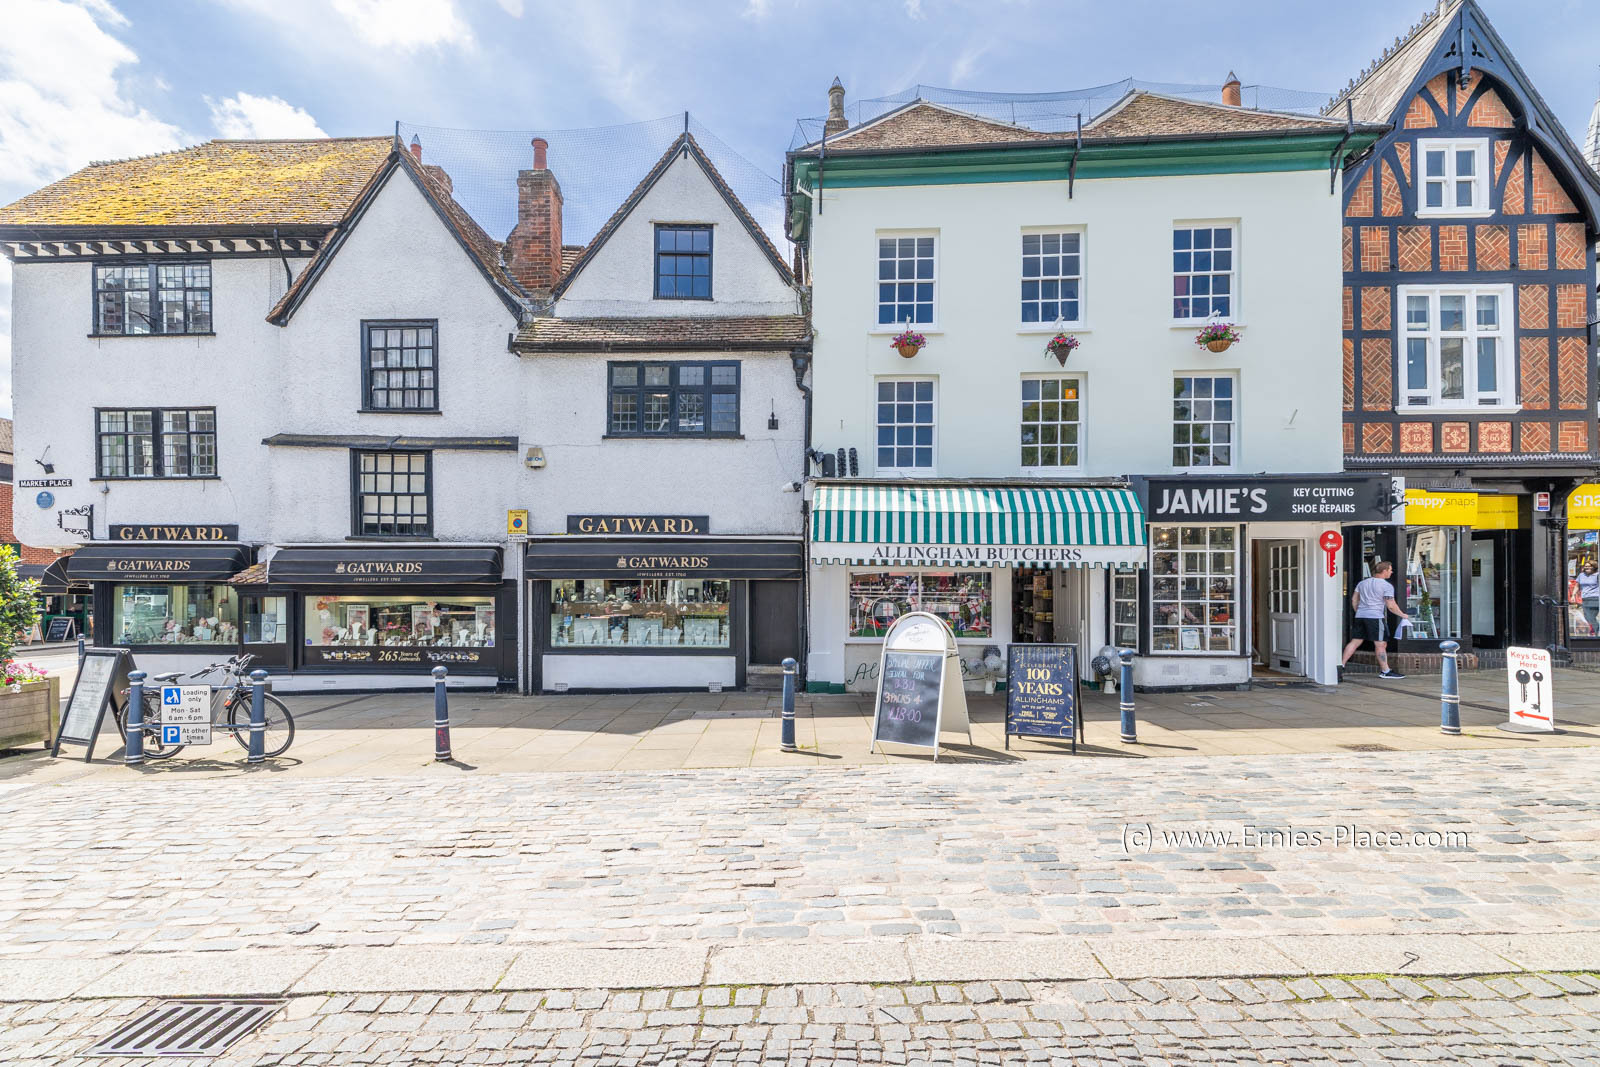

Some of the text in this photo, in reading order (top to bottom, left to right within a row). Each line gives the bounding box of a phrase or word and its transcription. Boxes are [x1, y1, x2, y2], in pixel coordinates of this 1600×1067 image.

[49, 479, 71, 487] PLACE
[1293, 487, 1355, 497] KEY CUTTING
[1156, 487, 1268, 514] JAMIE’S
[1292, 503, 1356, 514] SHOE REPAIRS
[579, 517, 699, 533] GATWARD.
[119, 527, 228, 540] GATWARD.
[872, 546, 1082, 560] ALLINGHAM BUTCHERS
[117, 560, 191, 571] GATWARDS
[347, 562, 423, 574] GATWARDS
[629, 557, 709, 568] GATWARDS
[378, 651, 398, 662] 265
[1510, 651, 1546, 661] Keys Cut
[1519, 660, 1538, 669] Here
[1026, 668, 1051, 680] 100
[1017, 681, 1063, 695] YEARS
[1015, 695, 1065, 705] ALLINGHAMS
